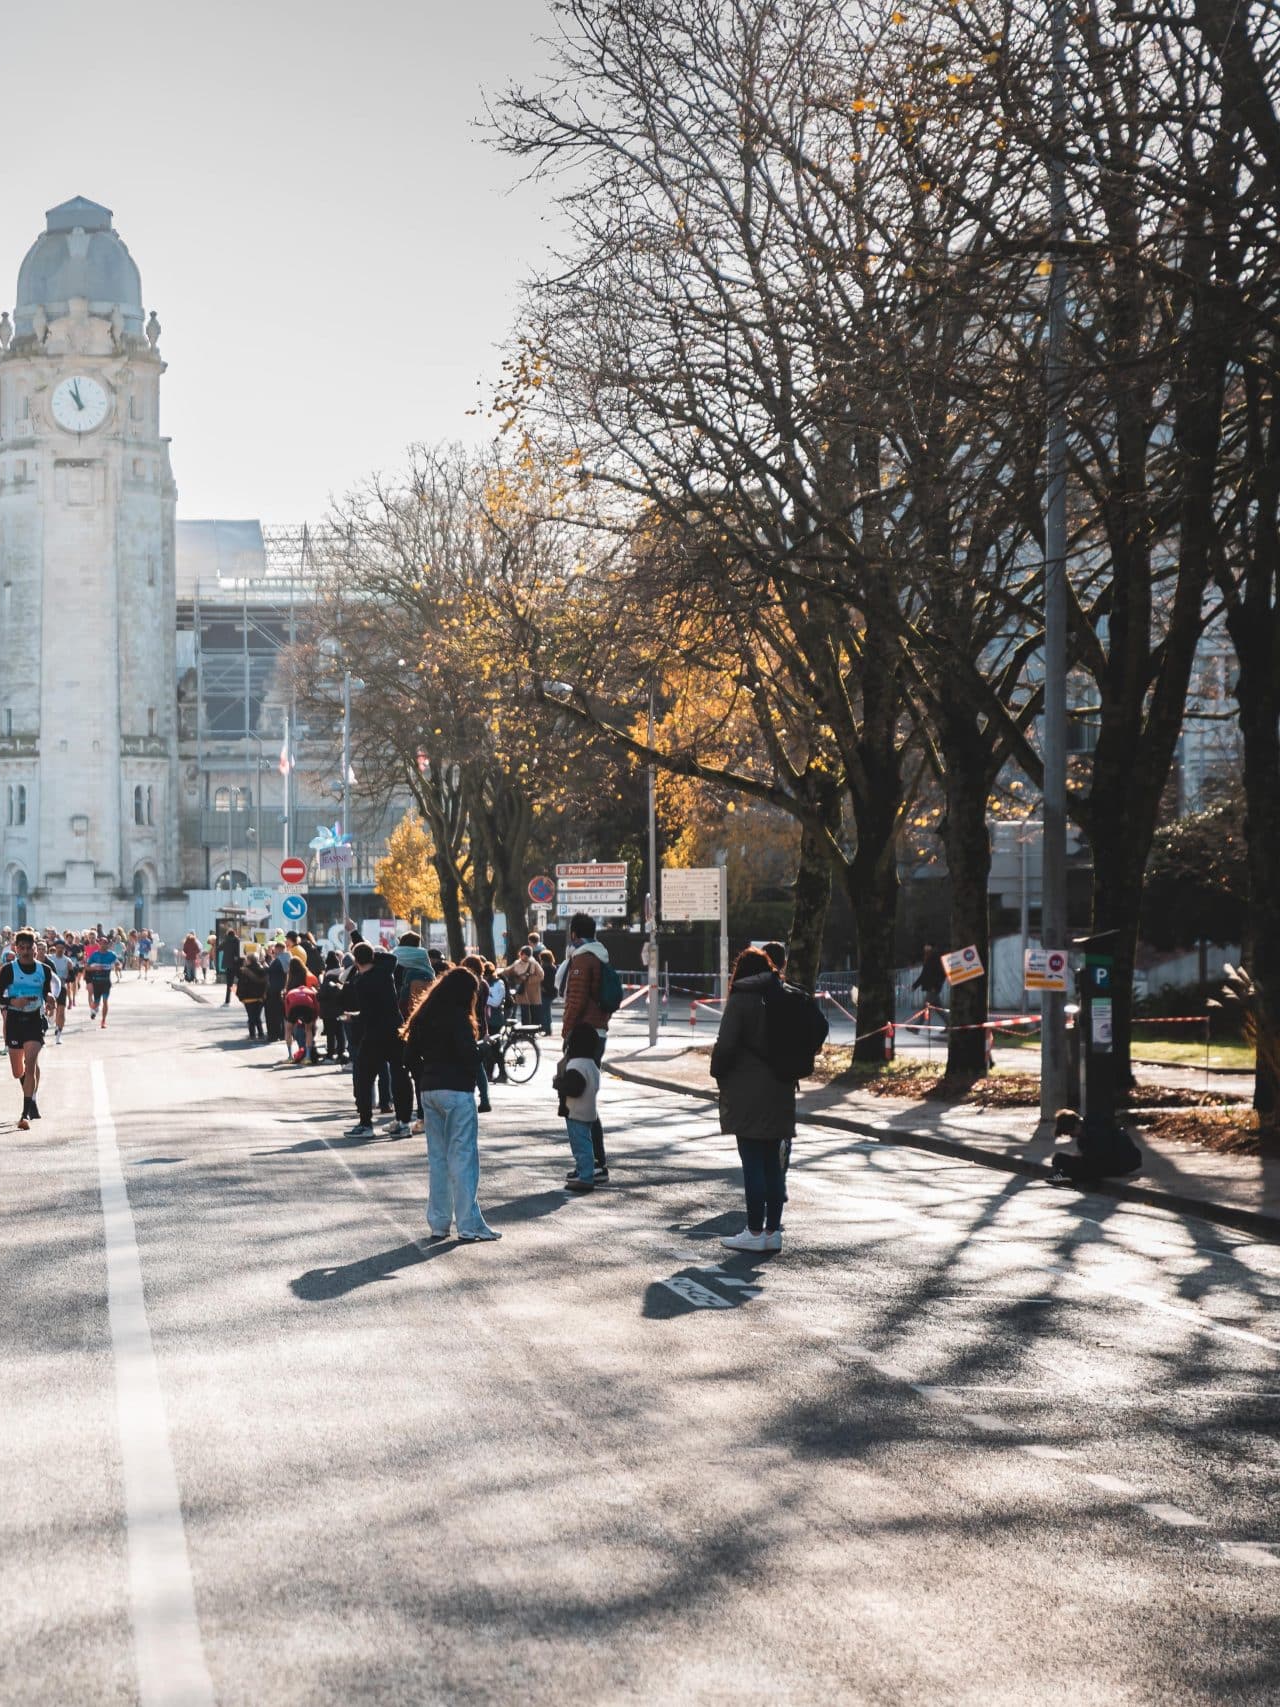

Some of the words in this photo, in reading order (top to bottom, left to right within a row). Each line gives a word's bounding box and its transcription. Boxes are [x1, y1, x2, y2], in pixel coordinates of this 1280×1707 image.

[568, 866, 585, 874] Porte
[586, 866, 601, 874] Saint
[1096, 968, 1107, 984] P
